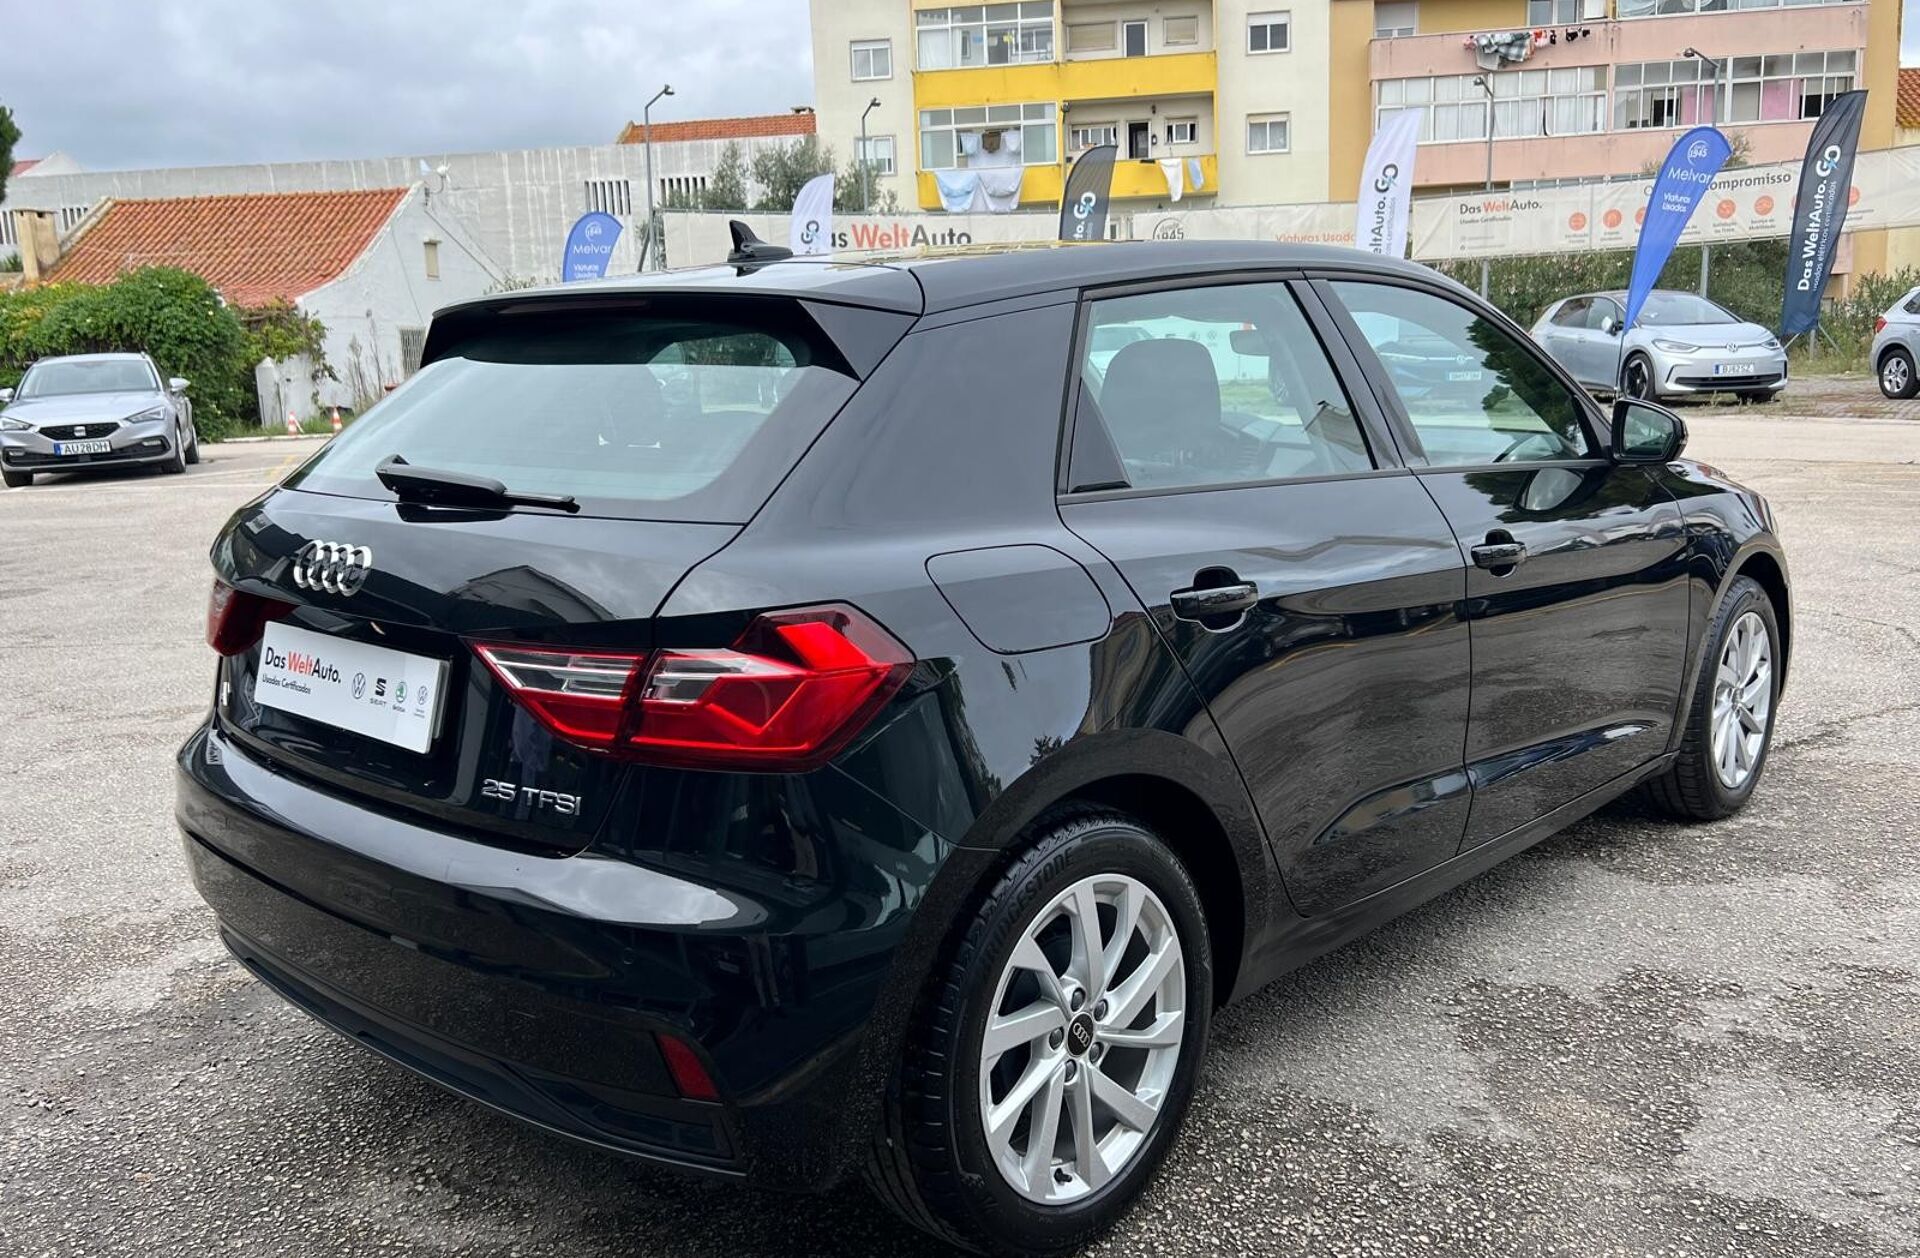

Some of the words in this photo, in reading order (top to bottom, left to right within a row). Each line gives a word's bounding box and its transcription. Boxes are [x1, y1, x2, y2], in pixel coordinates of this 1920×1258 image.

[1668, 166, 1712, 184] Melvar
[1706, 173, 1792, 192] ompromisso
[1460, 202, 1482, 214] Das
[1483, 199, 1543, 213] WeltAuto.
[1663, 192, 1691, 203] Viaturas
[1802, 179, 1827, 259] WeltAuto.
[573, 244, 612, 254] Melvar
[1797, 260, 1813, 291] Das
[64, 441, 108, 454] AU28DH
[264, 646, 287, 669] Das
[288, 652, 342, 684] WeltAuto.
[262, 674, 281, 686] Usados
[281, 677, 312, 695] Certificados
[481, 778, 517, 802] 25
[521, 786, 582, 816] TFSI
